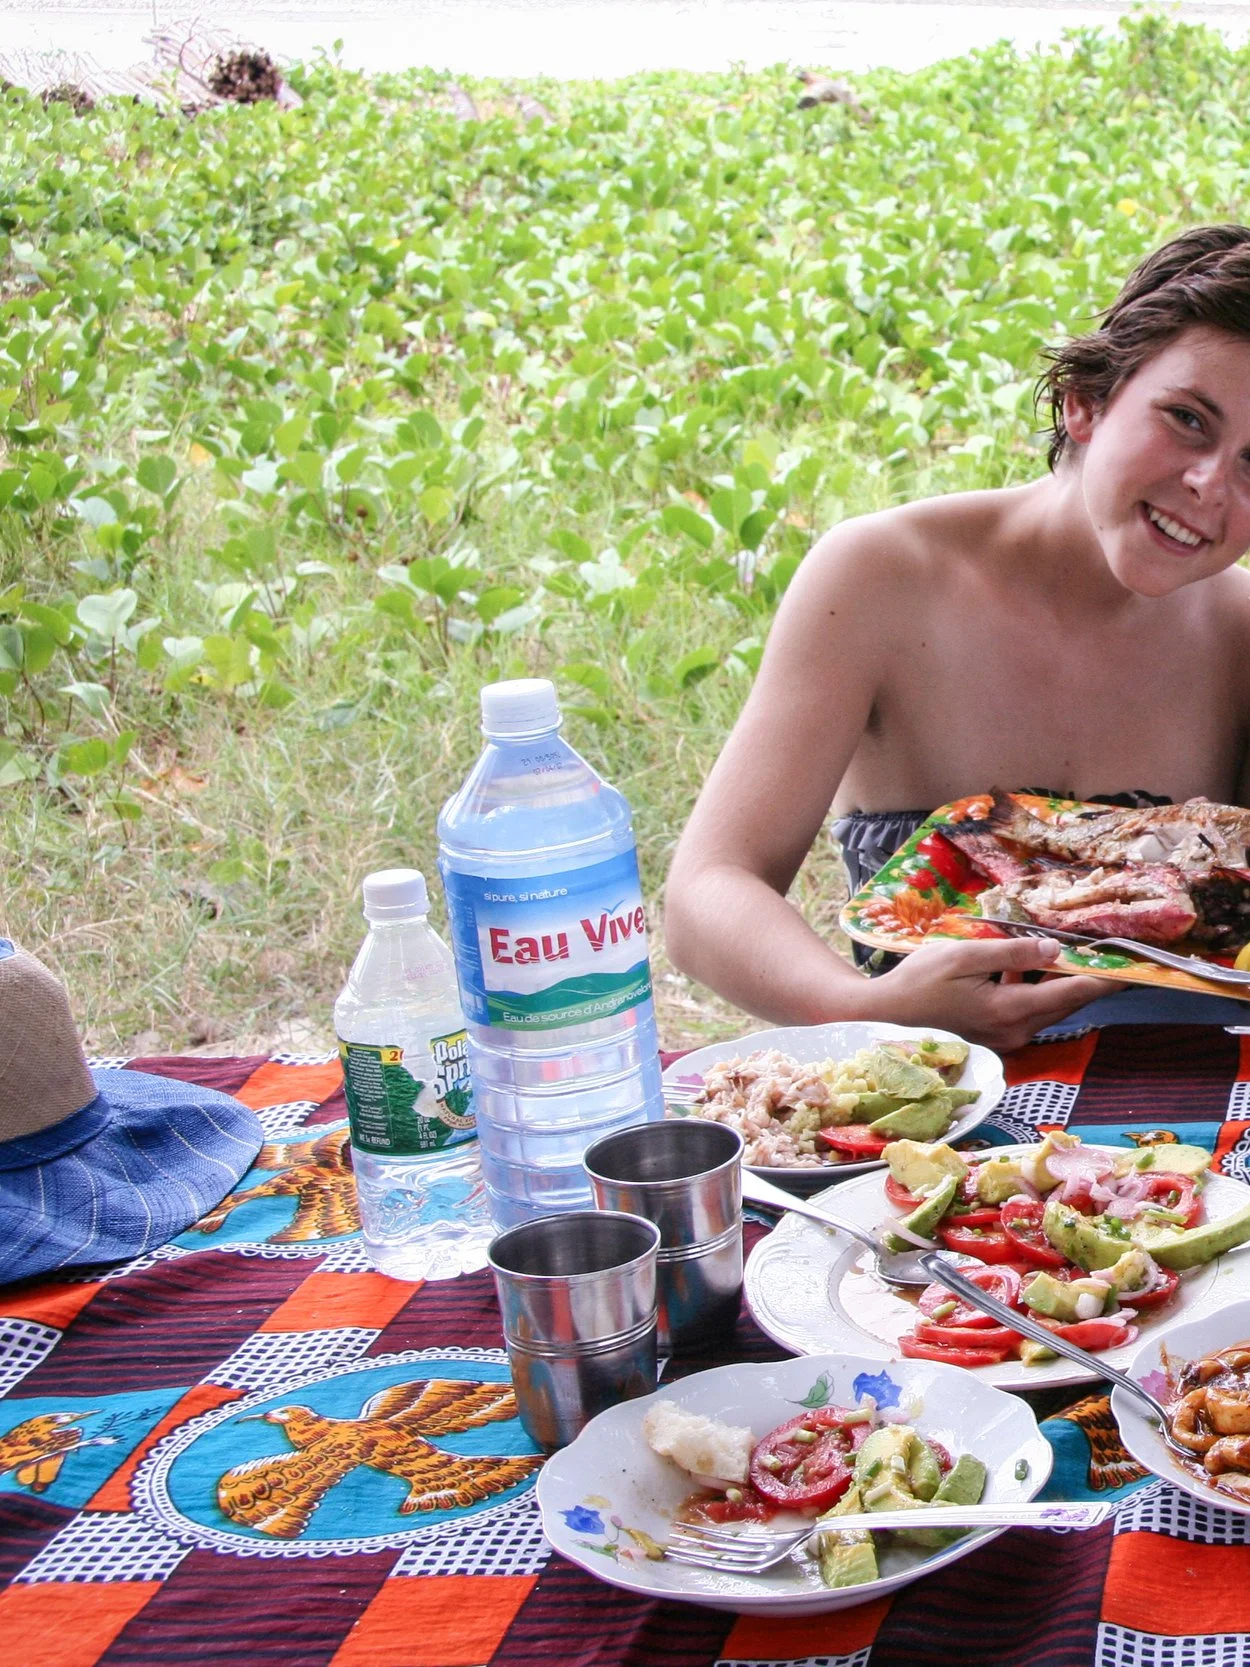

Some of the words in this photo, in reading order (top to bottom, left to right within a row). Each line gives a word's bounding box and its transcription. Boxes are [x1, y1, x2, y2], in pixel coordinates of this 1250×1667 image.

[530, 887, 568, 901] nature
[489, 927, 569, 964] Eau
[580, 906, 644, 952] Vive
[503, 1011, 523, 1023] Eau
[524, 1013, 540, 1023] de
[540, 1008, 582, 1021] source
